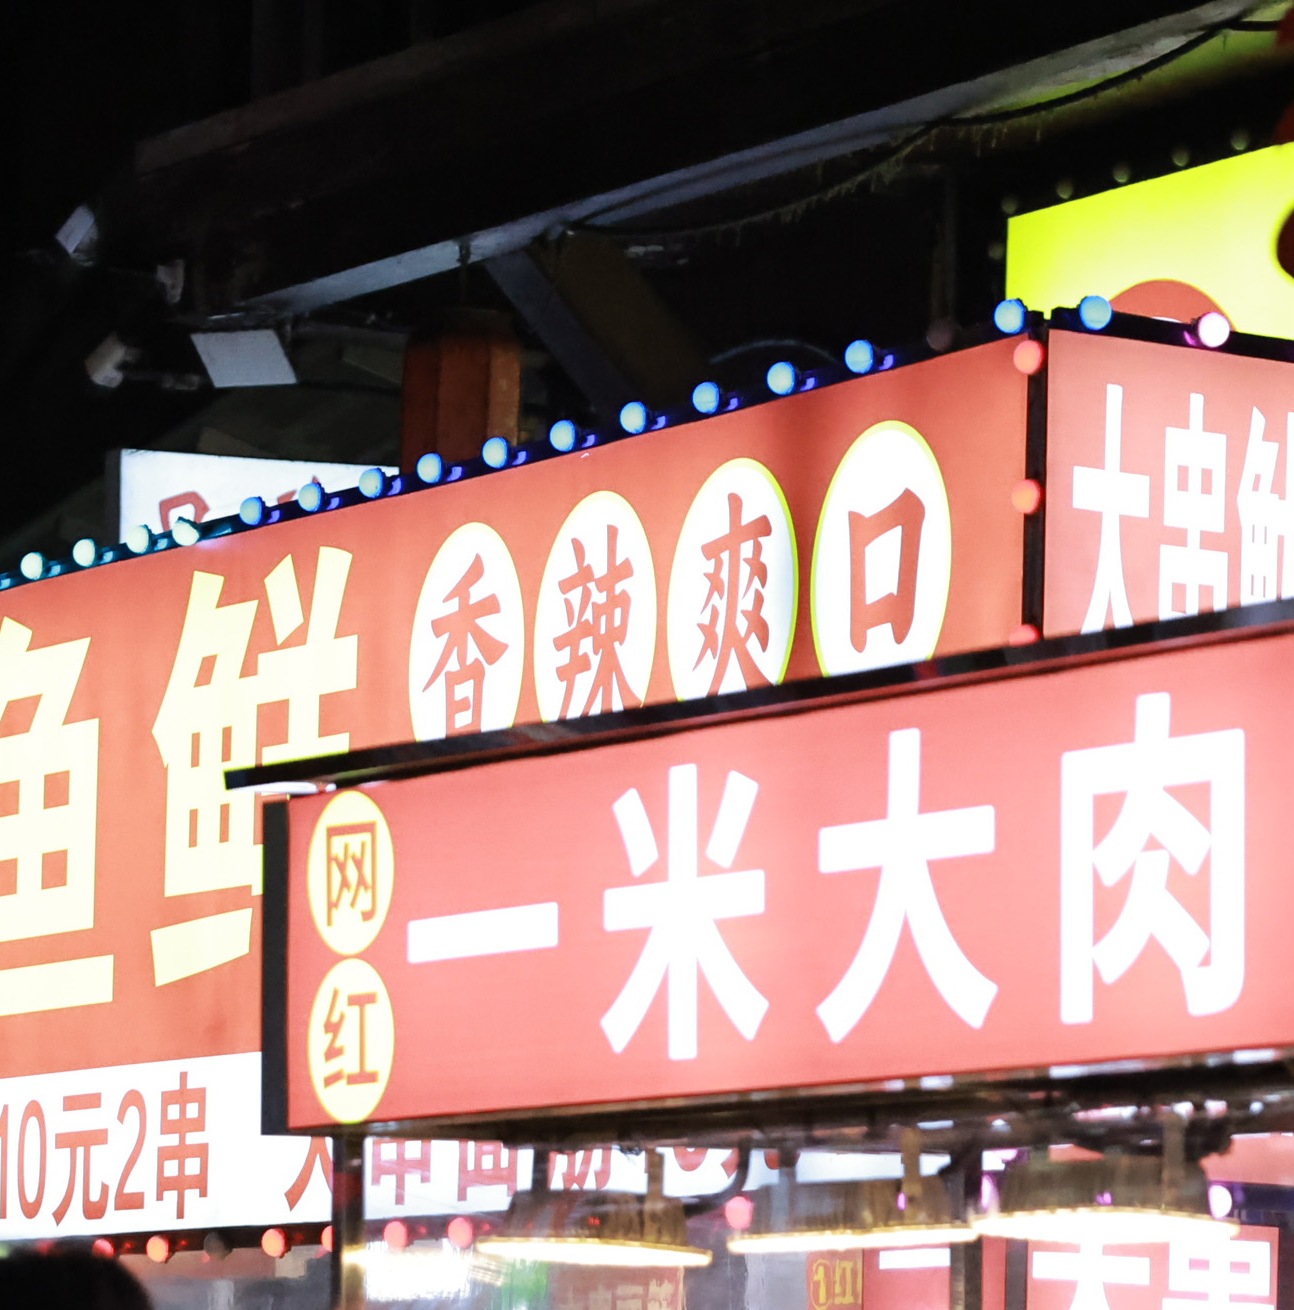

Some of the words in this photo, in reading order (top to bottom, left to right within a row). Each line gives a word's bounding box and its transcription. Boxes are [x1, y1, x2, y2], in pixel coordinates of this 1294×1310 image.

[422, 487, 927, 738] 香辣爽口
[322, 820, 380, 1089] 网红
